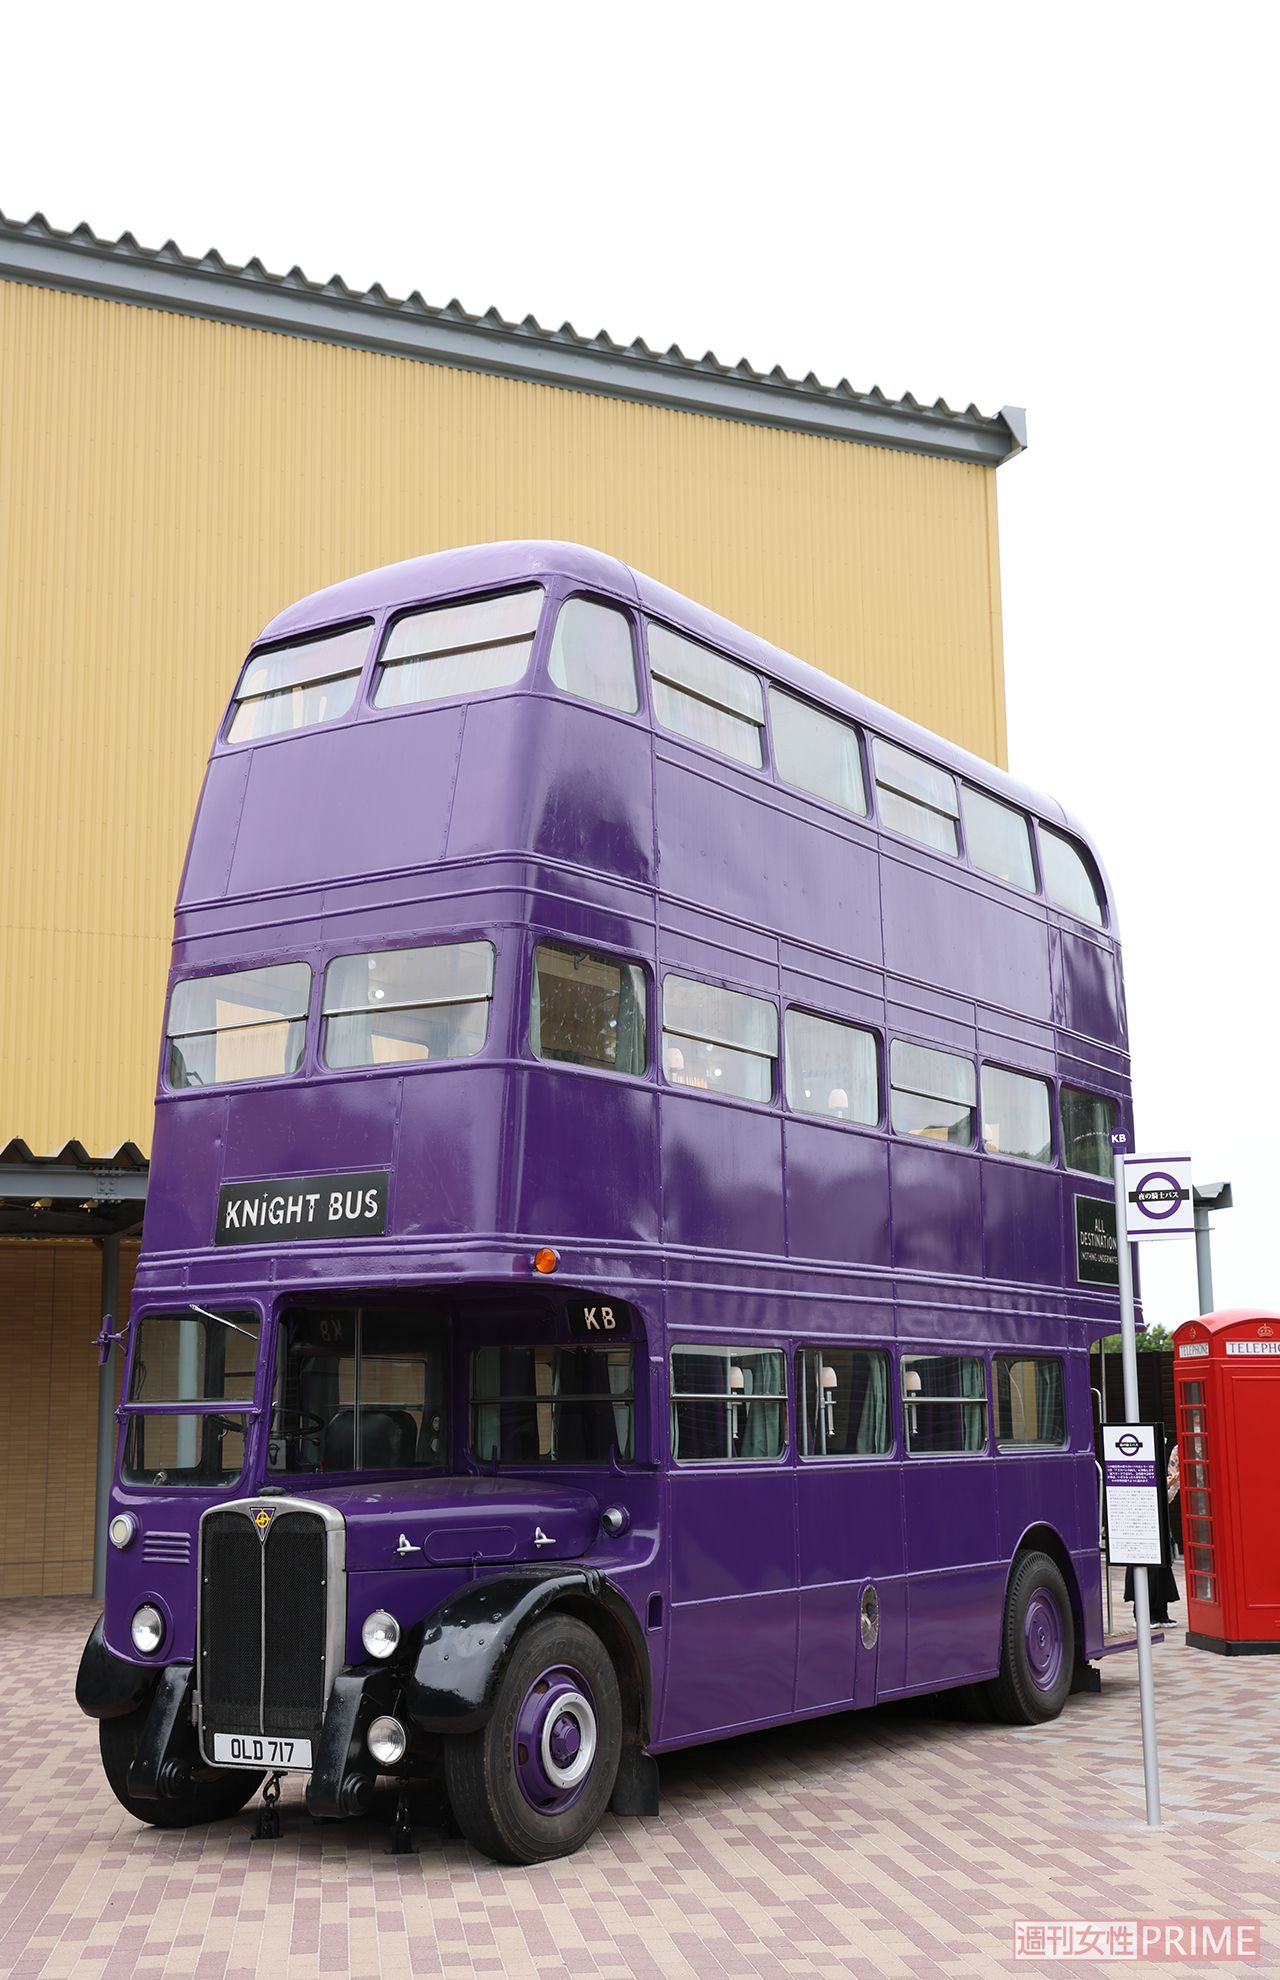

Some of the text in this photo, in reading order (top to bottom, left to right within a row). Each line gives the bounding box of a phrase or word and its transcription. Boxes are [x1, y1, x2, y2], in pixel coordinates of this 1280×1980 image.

[1111, 1134, 1127, 1143] KB
[1138, 1191, 1179, 1201] 夜の騎士バス
[225, 1189, 378, 1229] KNIGHT BUS
[1094, 1218, 1105, 1233] ALL
[1080, 1231, 1117, 1250] DESTINATION
[583, 1306, 616, 1330] KB
[231, 1738, 294, 1763] OLD 717
